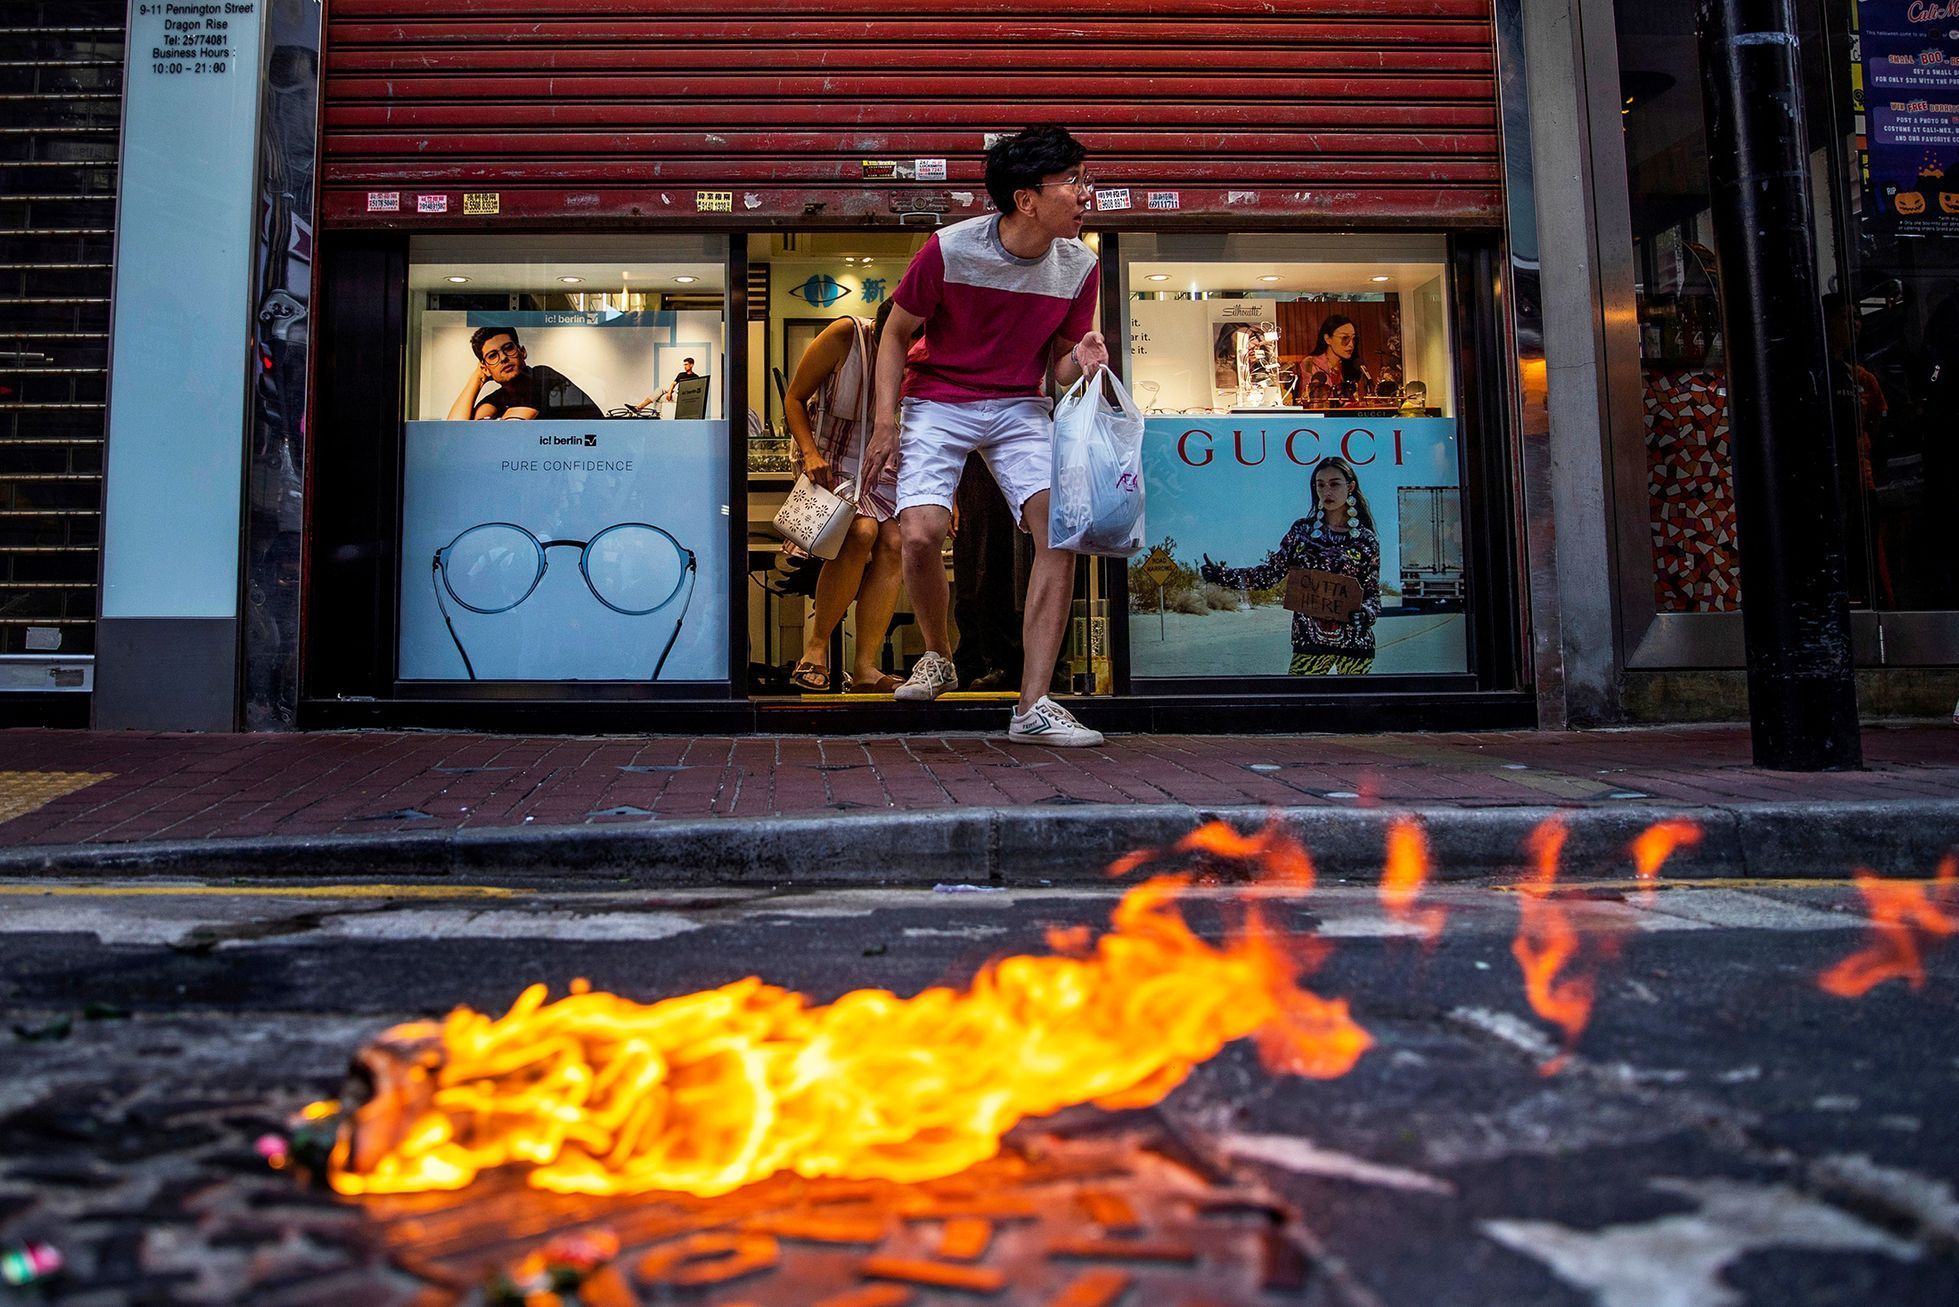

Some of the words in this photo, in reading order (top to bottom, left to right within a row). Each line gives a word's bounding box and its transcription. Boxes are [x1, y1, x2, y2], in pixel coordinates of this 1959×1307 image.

[140, 5, 162, 15] 9-11
[166, 4, 221, 16] Pennington
[225, 3, 254, 13] Street
[164, 19, 201, 31] Dragon
[206, 19, 229, 29] Rise
[164, 35, 180, 45] Tel:
[183, 35, 227, 45] 25774081
[152, 48, 197, 58] Business
[200, 47, 229, 57] Hours
[1889, 55, 1915, 64] SMALL
[152, 63, 183, 73] 10:00
[1908, 101, 1928, 112] FREE
[1222, 304, 1263, 317] Silhouette
[545, 314, 556, 323] ic!
[558, 314, 585, 323] berlin
[1141, 330, 1151, 341] it.
[1138, 344, 1148, 354] it.
[539, 435, 552, 446] ic!
[554, 435, 583, 446] berlin
[1176, 428, 1405, 467] GUCCI
[501, 460, 538, 471] PURE
[543, 460, 633, 471] CONFIDENCE
[1300, 574, 1349, 599] OUTTA
[1301, 592, 1345, 615] HERE
